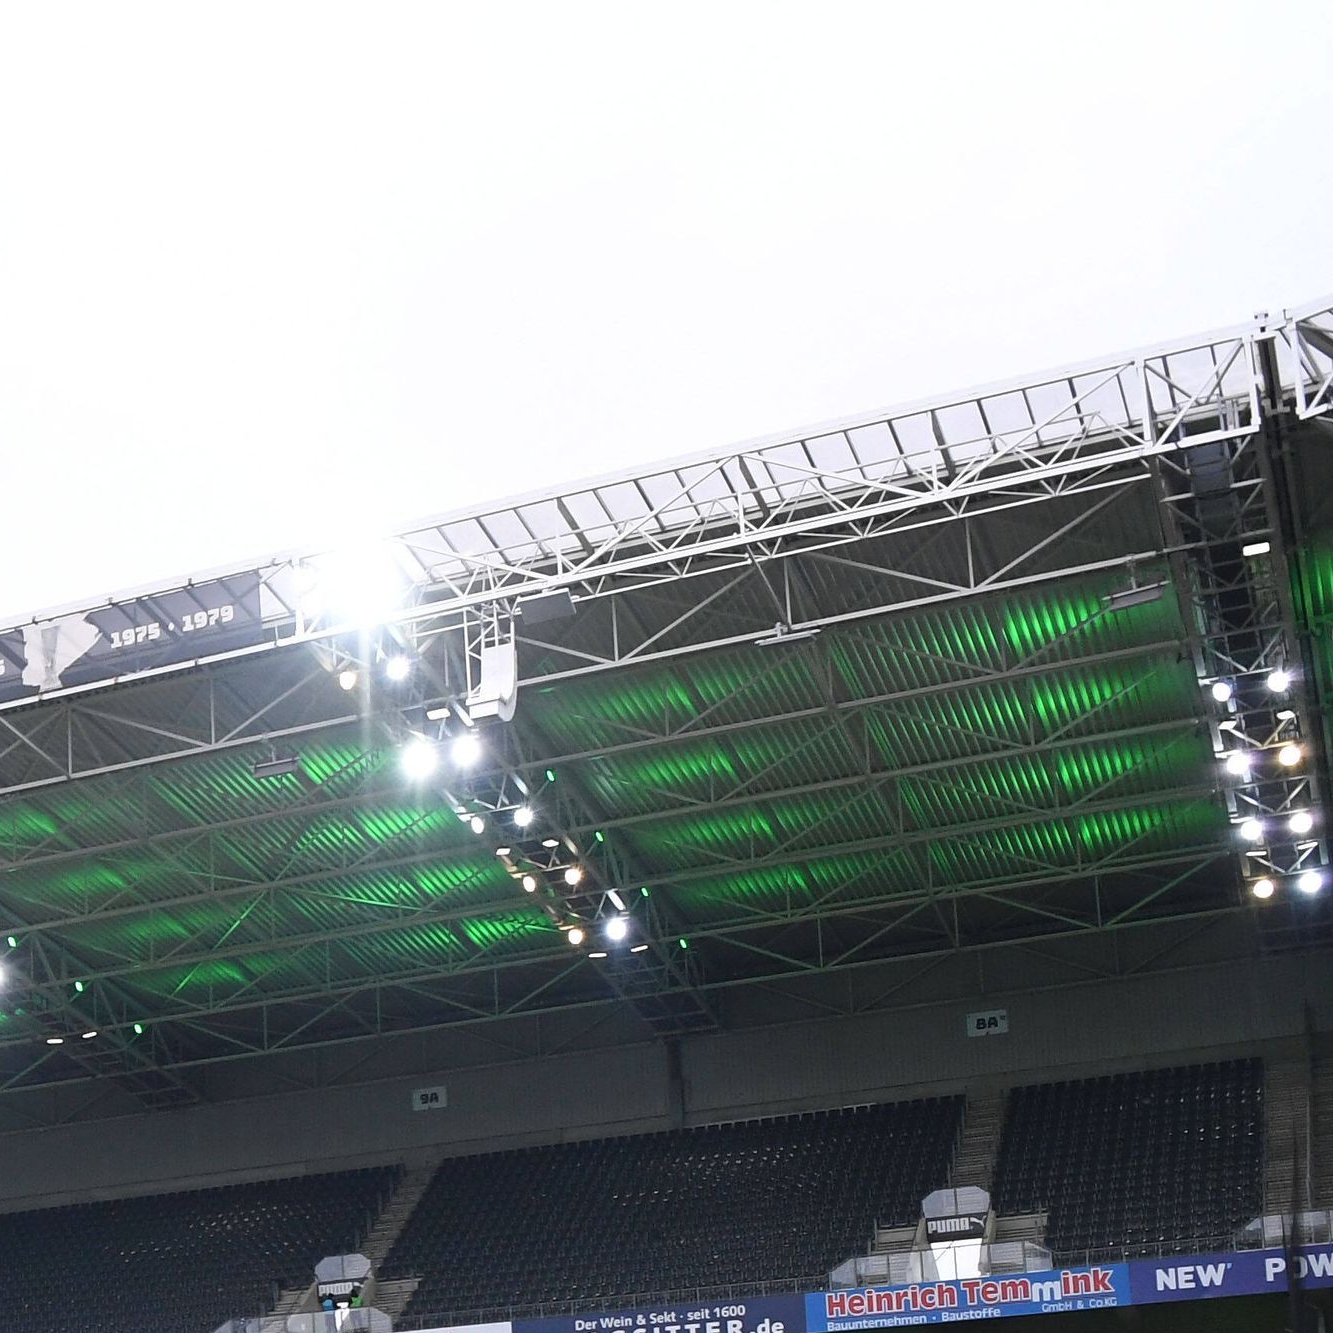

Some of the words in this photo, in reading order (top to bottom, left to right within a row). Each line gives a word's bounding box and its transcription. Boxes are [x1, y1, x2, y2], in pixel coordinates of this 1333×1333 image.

[111, 623, 160, 648] 1975
[182, 605, 234, 632] 1979
[927, 1217, 970, 1234] PUMA
[826, 1283, 957, 1318] Heinrich
[960, 1267, 1116, 1305] Temmink
[575, 1319, 597, 1331] Der
[600, 1316, 632, 1329] Wein
[636, 1315, 646, 1325] &
[649, 1311, 676, 1324] Sekt
[686, 1308, 710, 1321] seit
[713, 1304, 745, 1318] 1600
[827, 1314, 927, 1332] Bauunternehmen
[942, 1307, 1001, 1322] Baustoffe
[1042, 1301, 1073, 1313] GmbH
